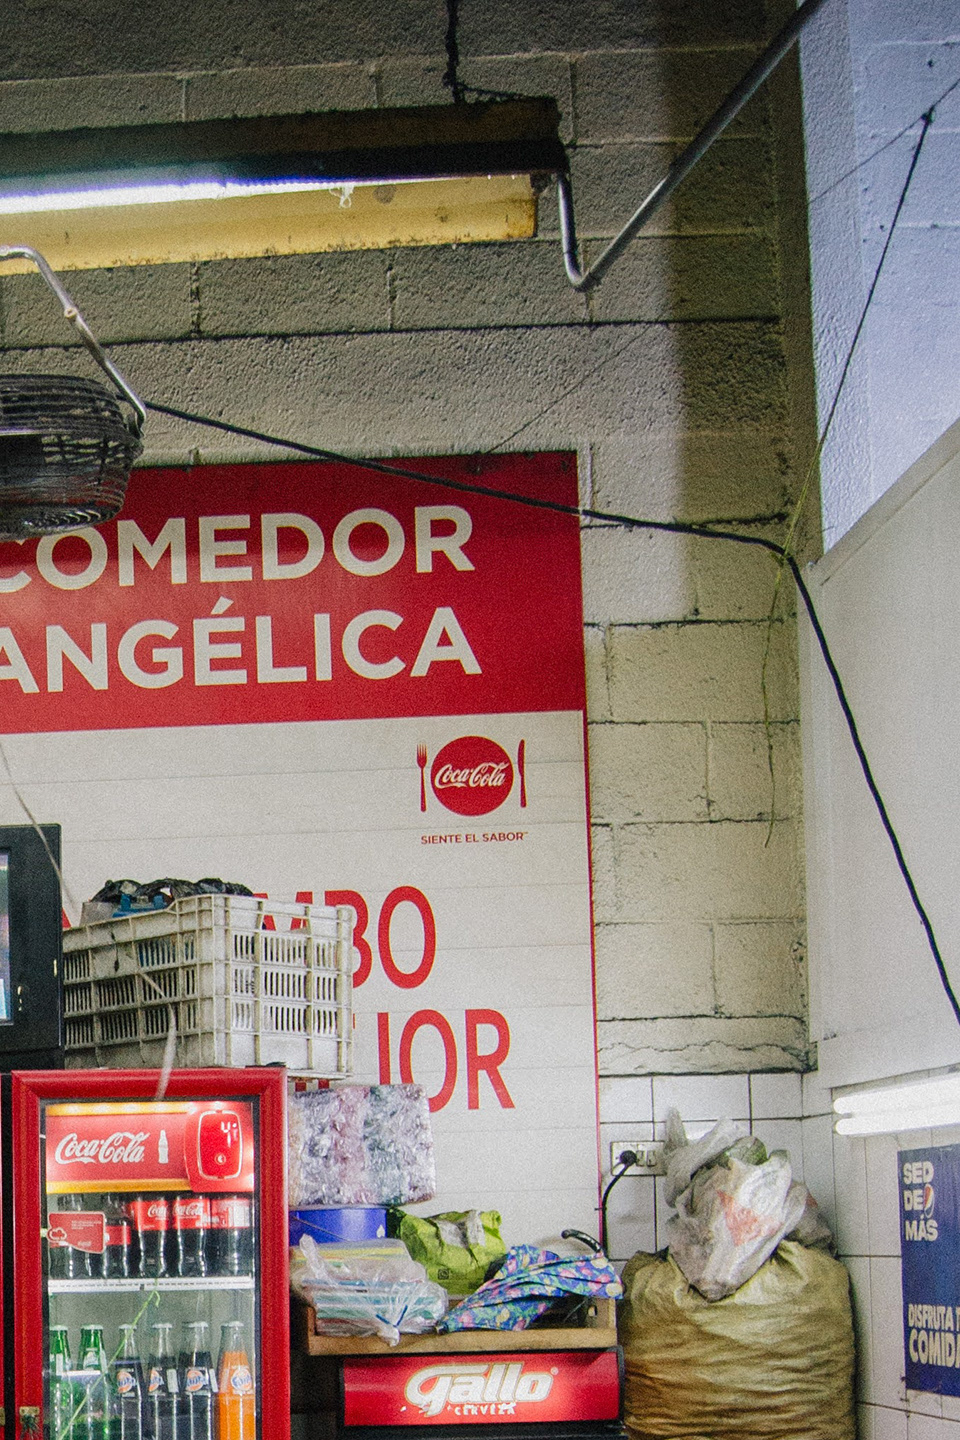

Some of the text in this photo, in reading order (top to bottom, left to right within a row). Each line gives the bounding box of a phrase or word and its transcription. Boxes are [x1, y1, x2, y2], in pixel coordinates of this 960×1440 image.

[435, 762, 509, 789] Coca-Cola
[421, 834, 462, 844] SIENTE
[465, 834, 479, 843] EL
[55, 1132, 150, 1165] Coca-Cola
[903, 1161, 934, 1185] SED
[904, 1190, 924, 1211] DE
[905, 1214, 938, 1241] MÁS
[908, 1303, 954, 1331] DISFRUTA
[405, 1361, 554, 1417] Gallo
